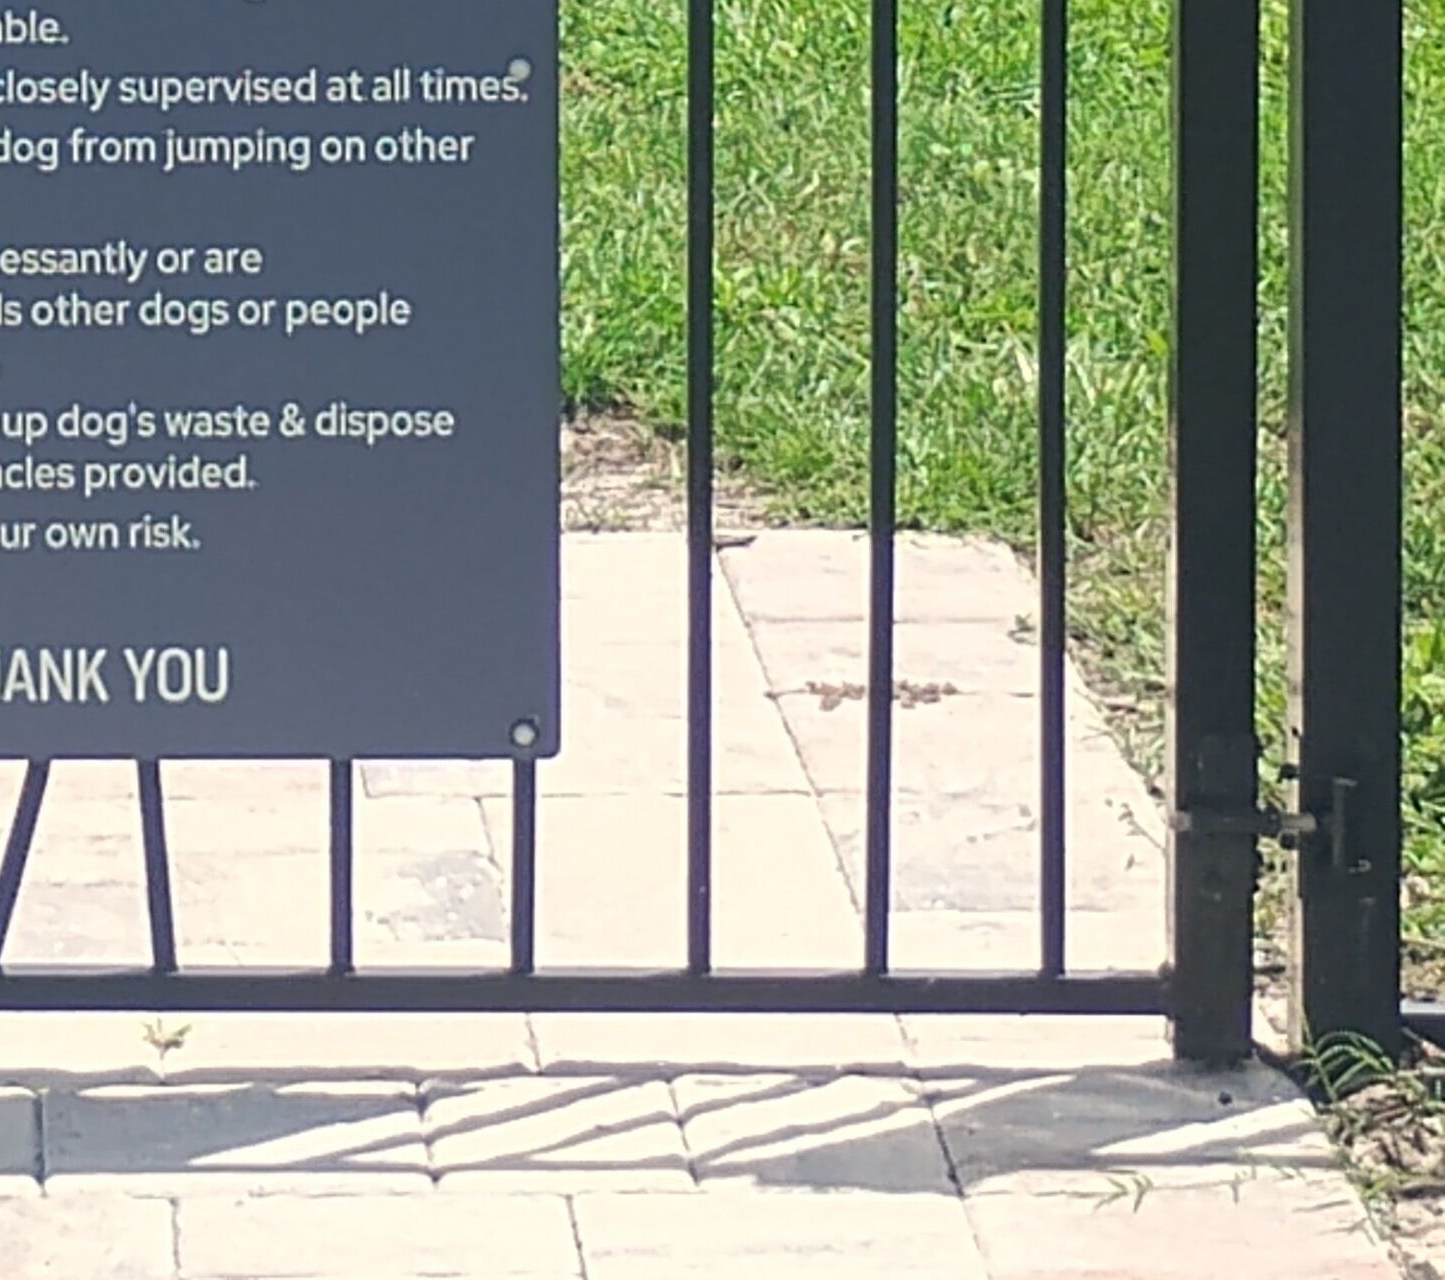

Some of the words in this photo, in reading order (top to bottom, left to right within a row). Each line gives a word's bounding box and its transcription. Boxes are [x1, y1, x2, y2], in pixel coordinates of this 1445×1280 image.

[118, 68, 317, 112] supervised
[325, 70, 367, 103] at
[371, 68, 411, 103] all
[419, 68, 530, 103] times.
[66, 126, 157, 163] from
[163, 127, 311, 172] jumping
[320, 135, 366, 163] on
[374, 126, 475, 163] other
[156, 247, 196, 274] or
[203, 247, 263, 274] are
[30, 291, 132, 327] other
[138, 290, 230, 335] dogs
[237, 298, 278, 326] or
[285, 290, 412, 336] people
[1, 411, 49, 447] up
[56, 401, 157, 447] dog's
[163, 404, 271, 439] waste
[279, 402, 306, 438] &
[314, 401, 455, 446] dispose
[84, 454, 257, 499] provided.
[44, 522, 120, 550] own
[129, 513, 201, 550] risk.
[123, 647, 229, 703] YOU
